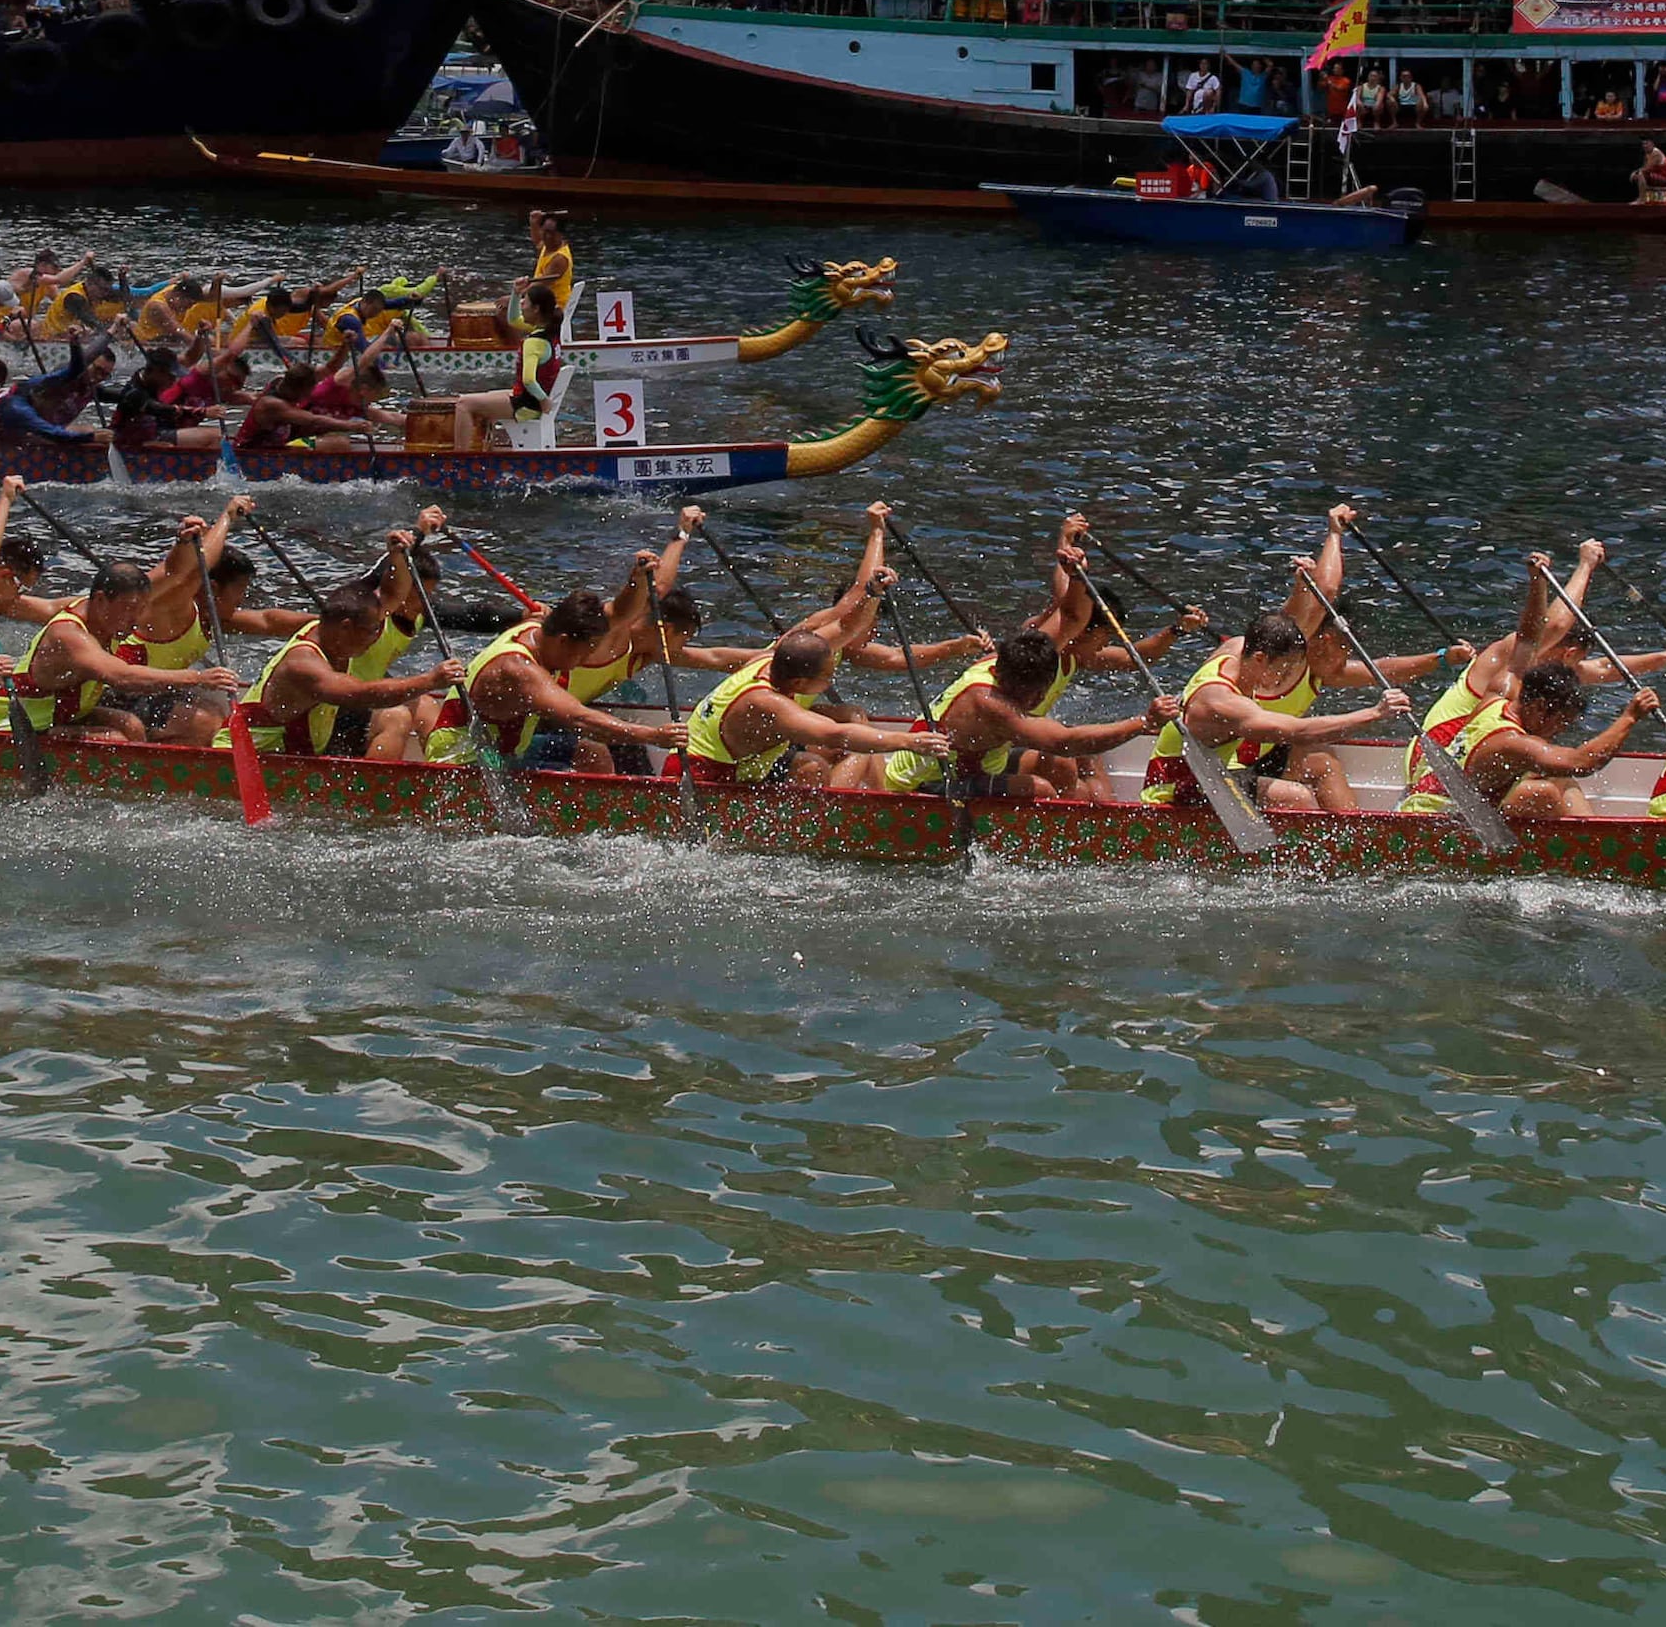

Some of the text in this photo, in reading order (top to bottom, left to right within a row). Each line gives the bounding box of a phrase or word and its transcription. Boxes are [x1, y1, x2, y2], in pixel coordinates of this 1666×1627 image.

[604, 301, 626, 333] 4
[631, 347, 690, 363] 宏森集團
[603, 393, 635, 437] 3
